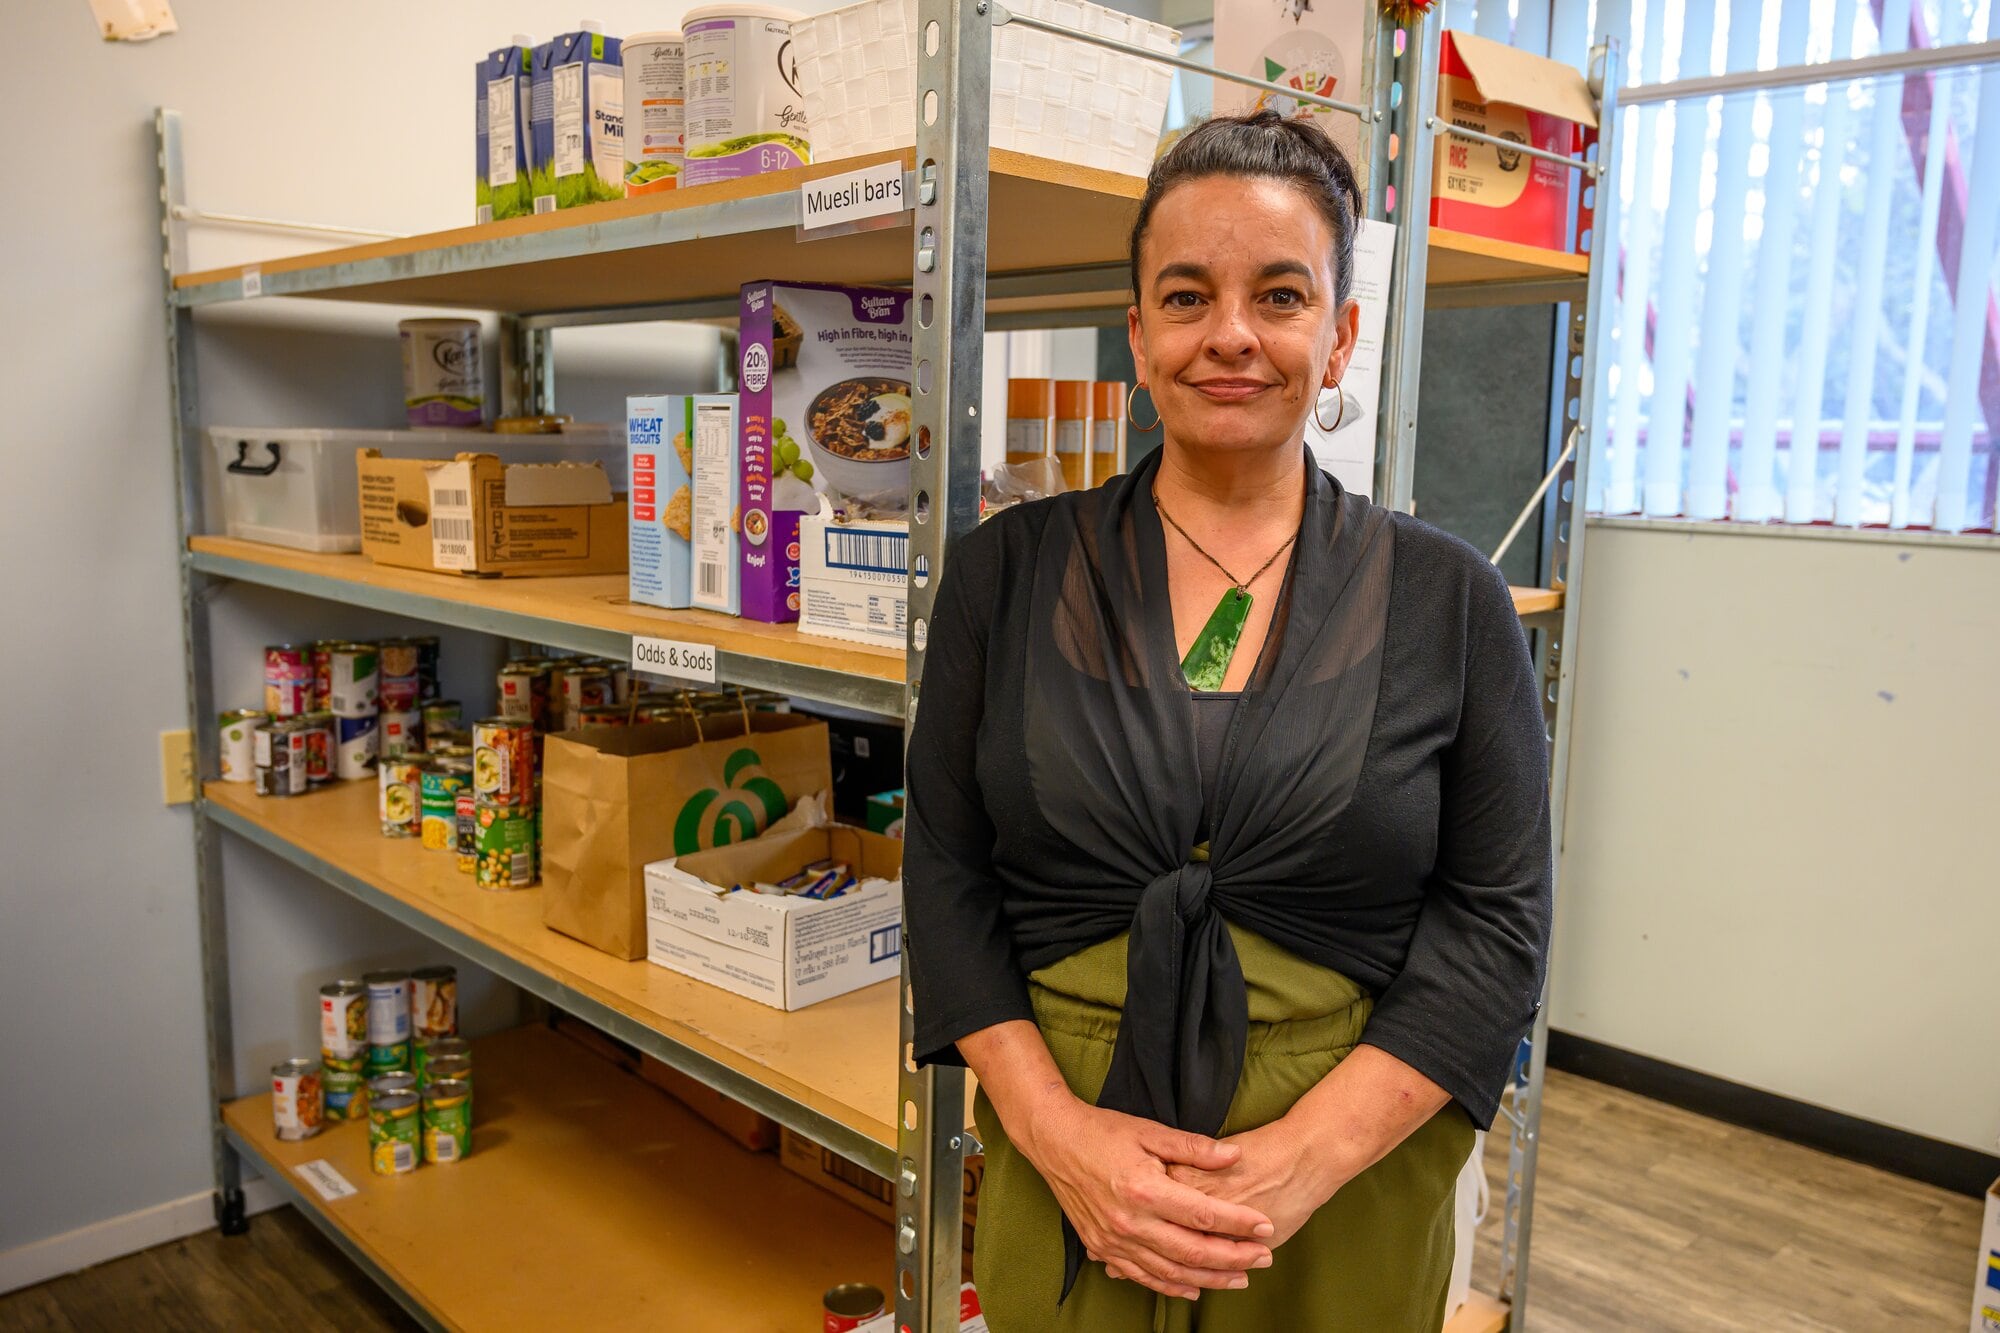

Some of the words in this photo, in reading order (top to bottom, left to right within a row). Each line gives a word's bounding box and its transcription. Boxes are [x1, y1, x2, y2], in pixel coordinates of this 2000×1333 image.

[761, 149, 790, 170] 6-12
[1449, 145, 1468, 170] RICE
[807, 182, 859, 214] Muesli
[864, 179, 901, 202] bars
[861, 296, 896, 310] Sultana
[867, 307, 890, 319] Bran
[817, 329, 840, 343] High
[841, 328, 850, 339] in
[878, 329, 897, 343] high
[899, 331, 908, 341] in
[746, 351, 767, 368] 20%
[746, 373, 766, 385] FIBRE
[629, 417, 663, 433] WHEAT
[630, 433, 661, 445] BISCUITS
[746, 553, 766, 568] Enjoy!
[636, 643, 666, 664] Odds
[669, 647, 679, 666] &
[682, 649, 713, 671] Sods
